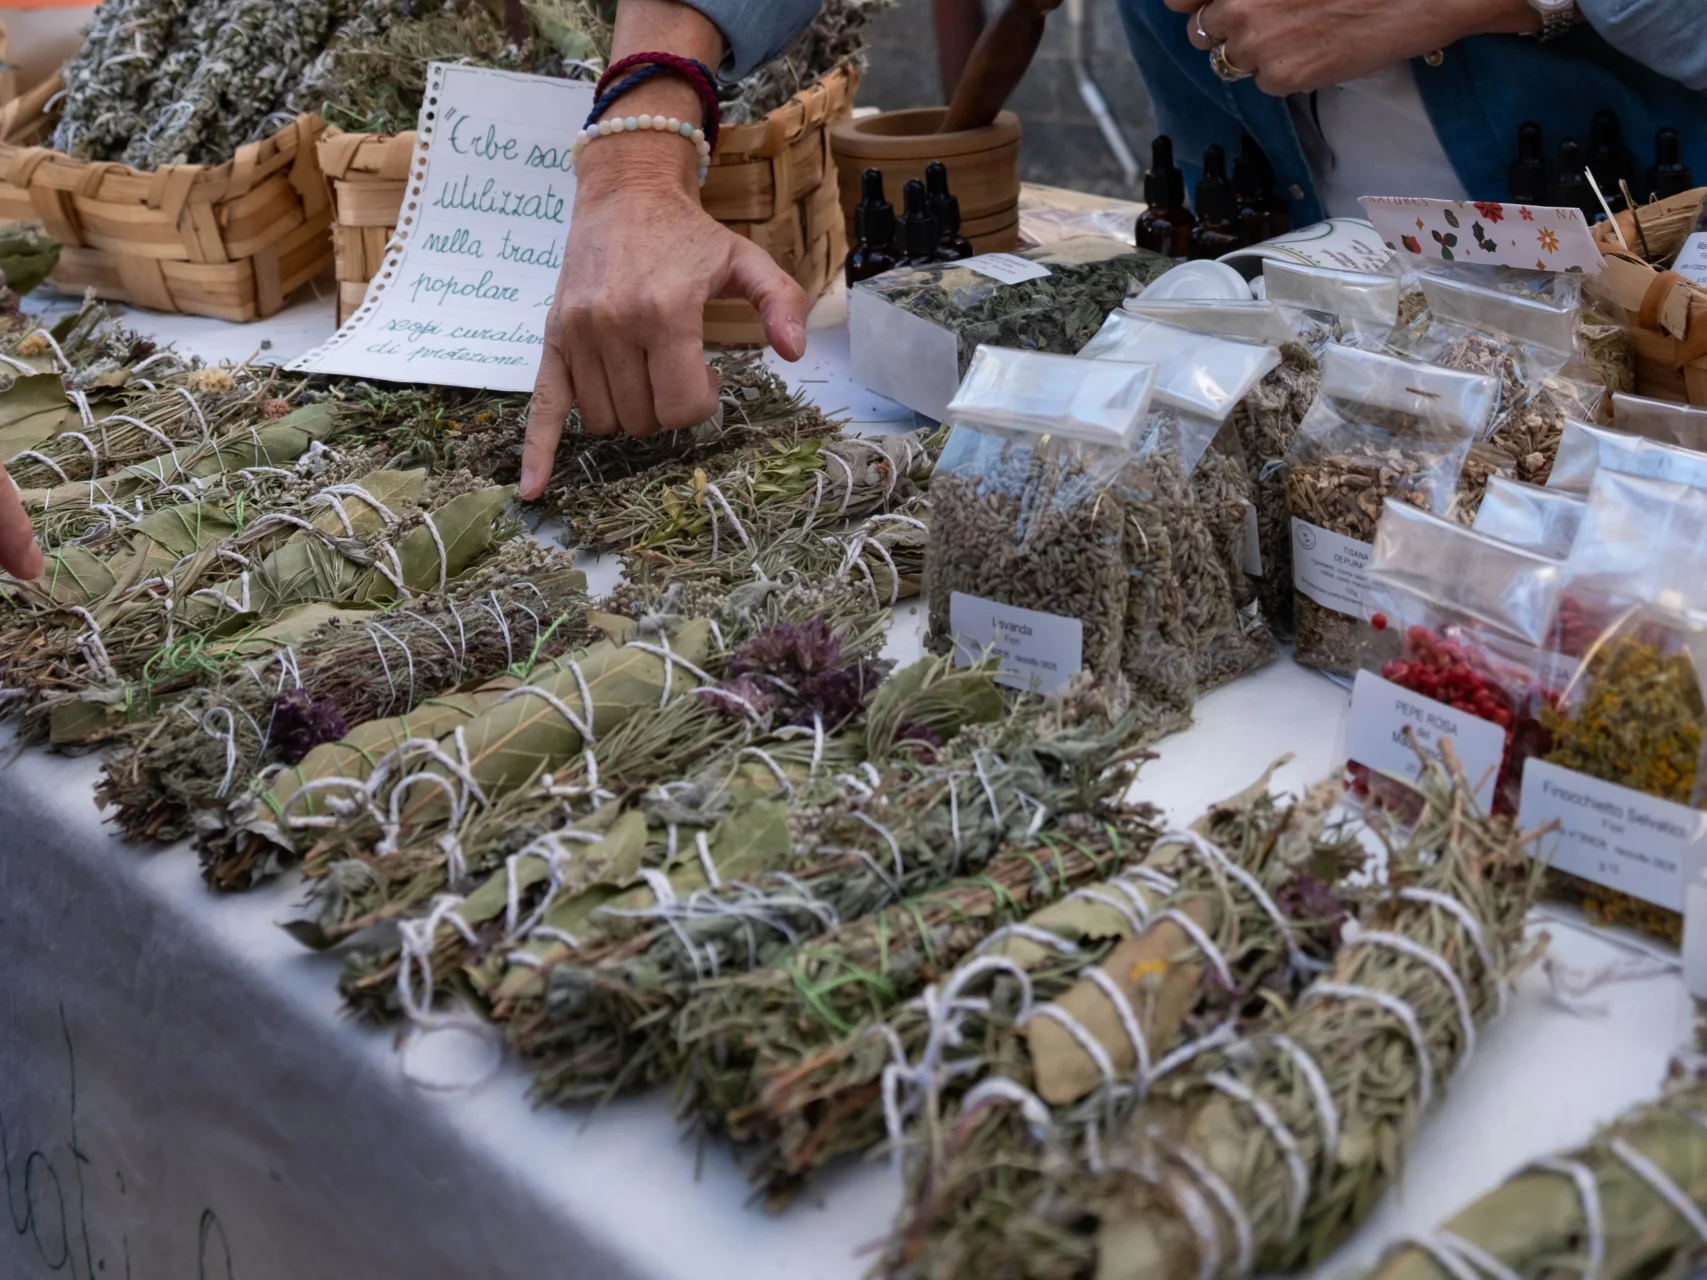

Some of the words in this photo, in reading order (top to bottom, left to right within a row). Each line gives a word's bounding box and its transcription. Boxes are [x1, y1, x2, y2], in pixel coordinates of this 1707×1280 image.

[422, 228, 483, 257] nella
[409, 270, 519, 306] popolare
[367, 338, 400, 355] di
[1334, 554, 1366, 569] DEPURA
[1343, 546, 1369, 560] TISANA
[992, 616, 1033, 636] Lavanda
[1395, 699, 1425, 722] PEPE
[1426, 713, 1458, 736] ROSA
